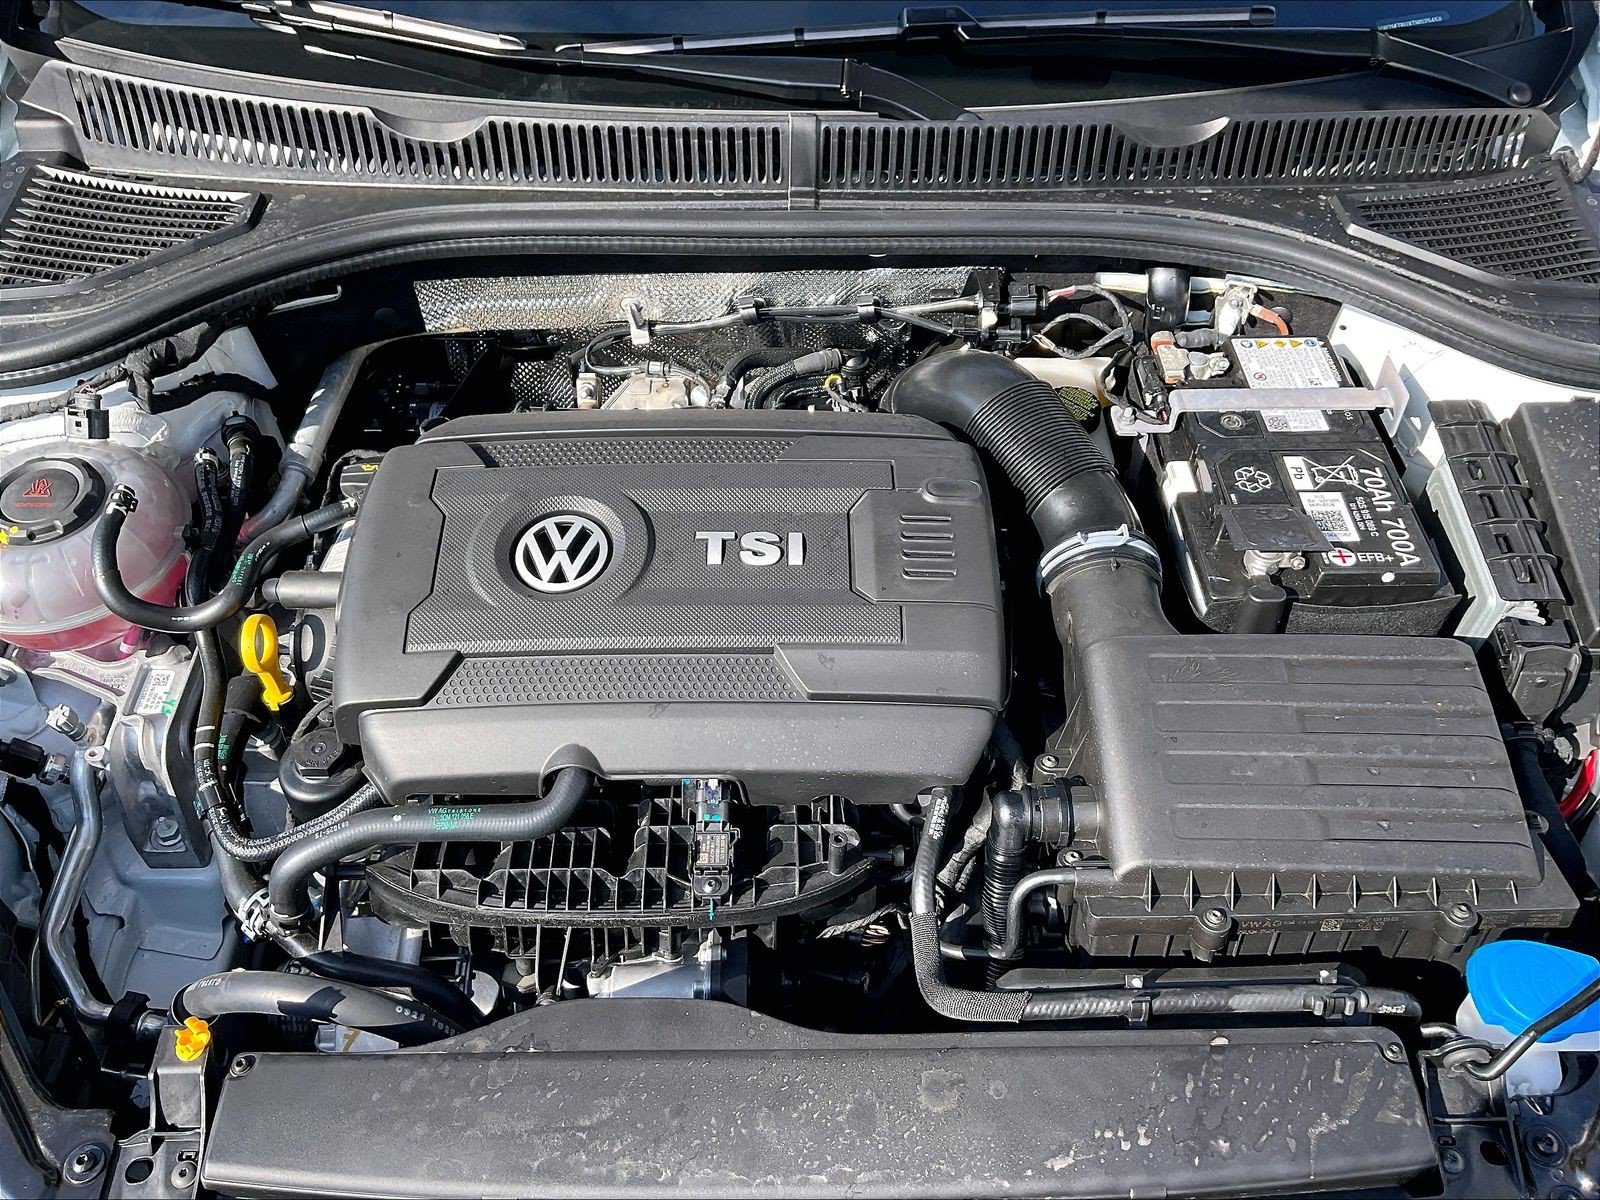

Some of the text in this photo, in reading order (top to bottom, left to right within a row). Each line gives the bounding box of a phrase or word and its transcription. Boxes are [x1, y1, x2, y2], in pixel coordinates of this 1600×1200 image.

[1290, 466, 1304, 480] Pb
[1359, 467, 1421, 567] 70Ah 700A
[694, 530, 805, 567] TSI
[1356, 552, 1394, 563] EFB+
